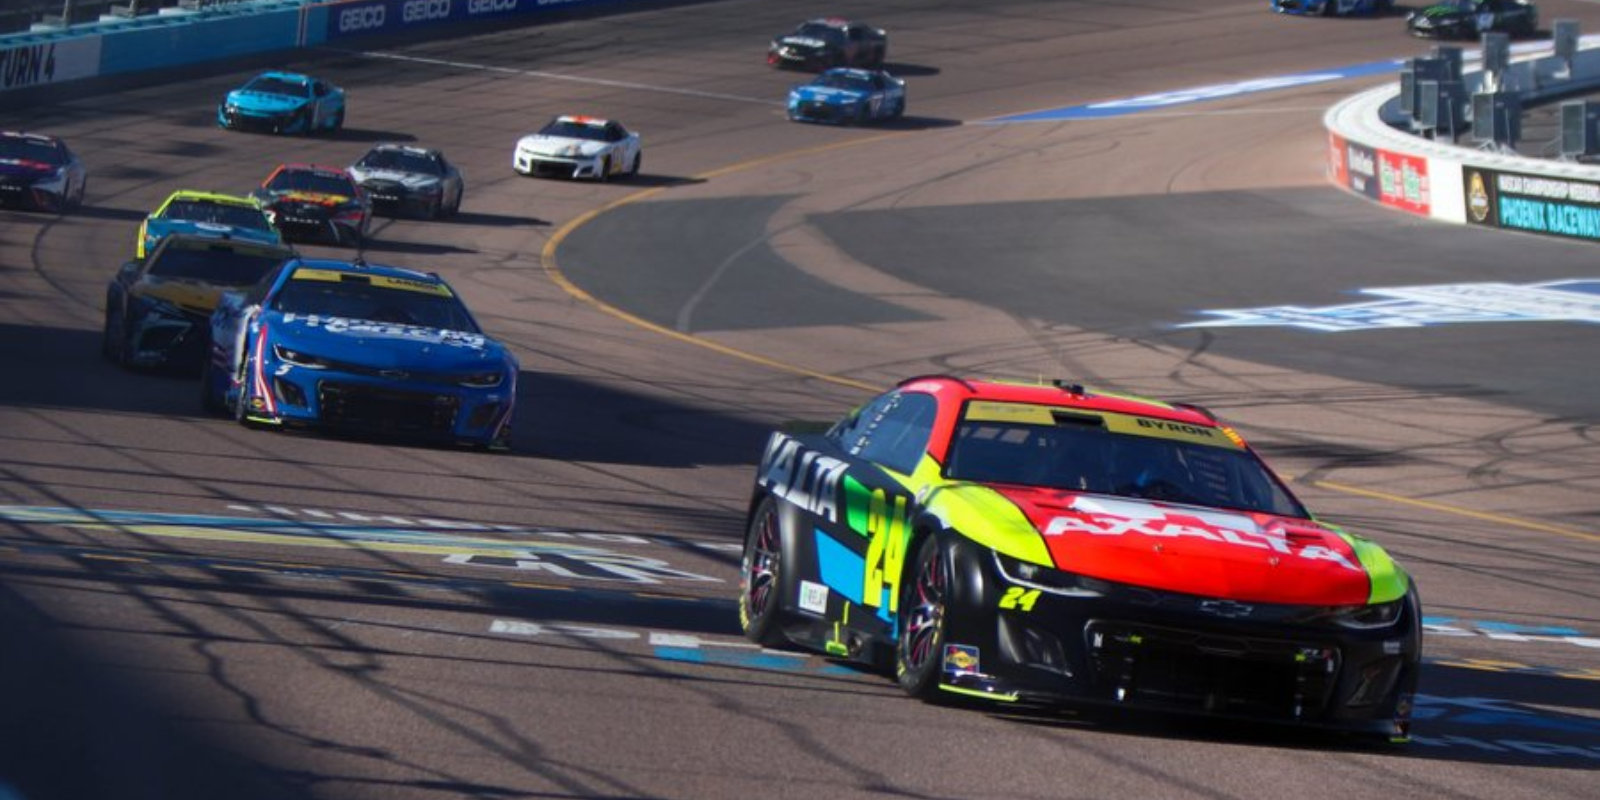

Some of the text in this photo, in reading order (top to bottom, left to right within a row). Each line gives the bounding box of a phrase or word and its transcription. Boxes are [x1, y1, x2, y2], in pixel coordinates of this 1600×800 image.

[339, 6, 386, 32] GEICO
[403, 0, 450, 22] GEICO
[44, 42, 56, 80] 4
[1500, 196, 1548, 231] PHOENIX
[1136, 418, 1213, 437] BYRON
[864, 488, 906, 613] 24
[1045, 515, 1362, 572] AXALTA
[999, 586, 1042, 612] 24
